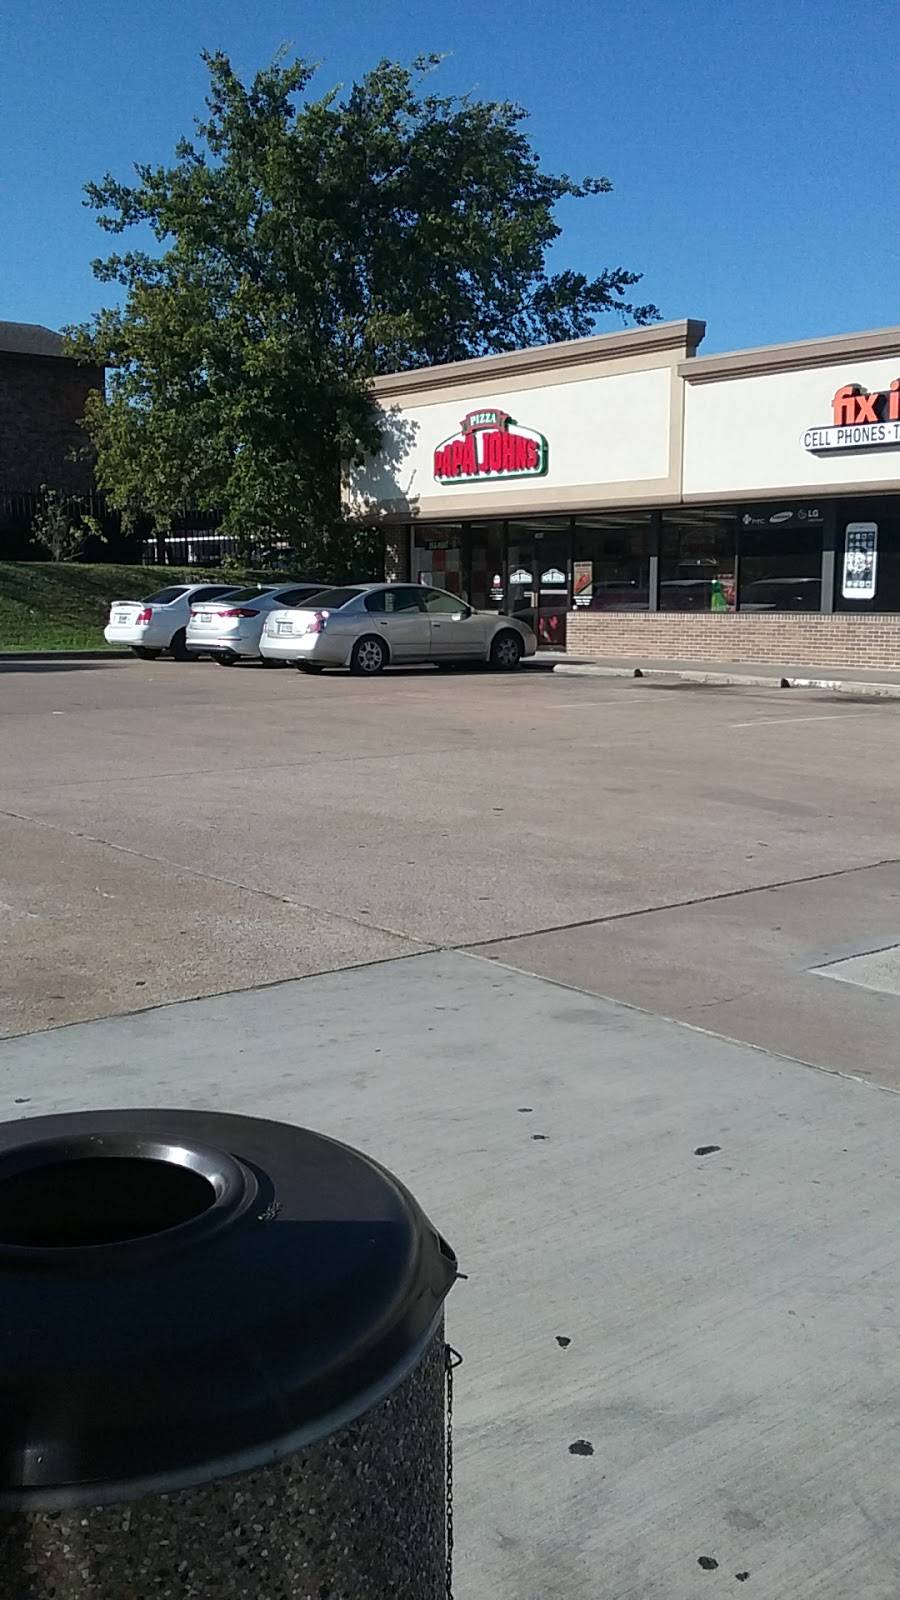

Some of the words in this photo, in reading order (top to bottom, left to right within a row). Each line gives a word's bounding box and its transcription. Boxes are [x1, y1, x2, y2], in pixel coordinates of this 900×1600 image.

[470, 413, 496, 425] PIZZA
[831, 385, 878, 425] fix
[804, 431, 831, 447] CELL
[837, 426, 885, 444] PHONES
[434, 433, 476, 477] PAPA
